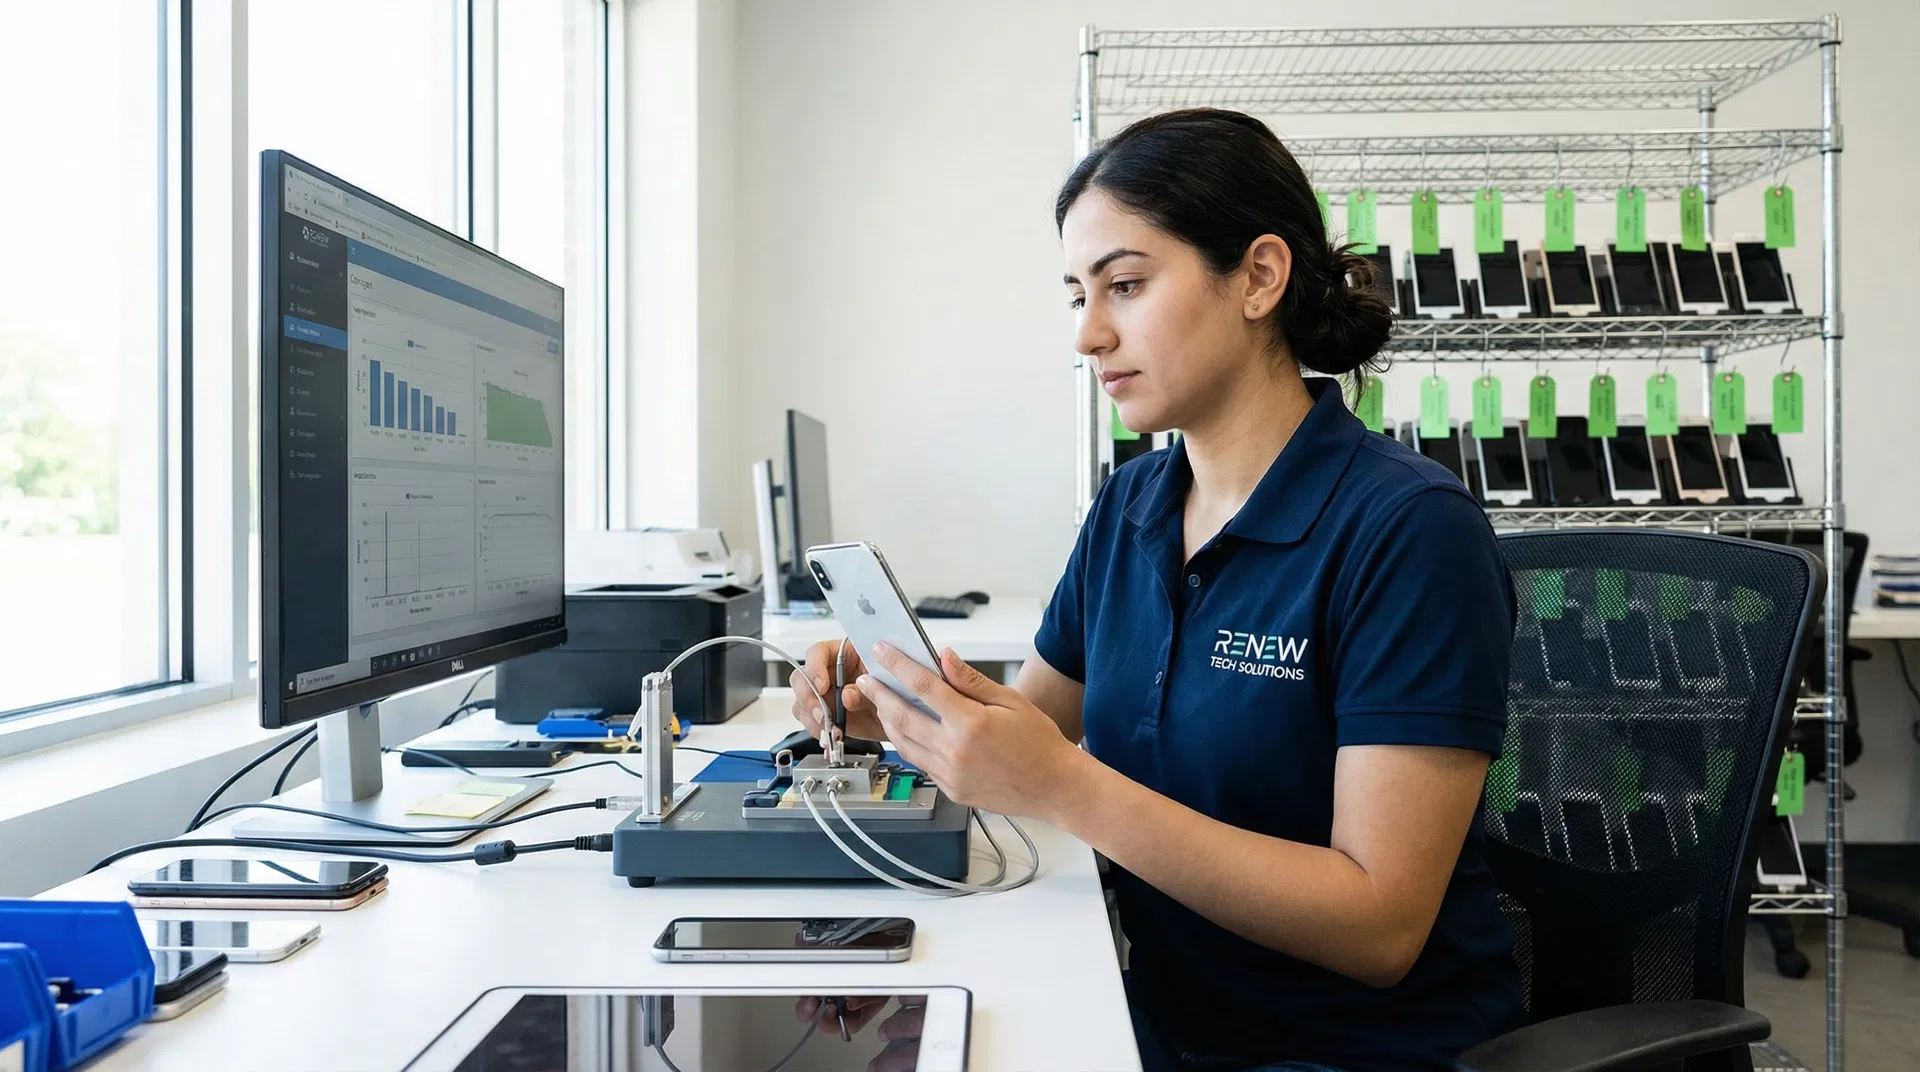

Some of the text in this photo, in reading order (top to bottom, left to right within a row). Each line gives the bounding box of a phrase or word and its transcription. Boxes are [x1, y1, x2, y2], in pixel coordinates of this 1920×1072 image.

[1214, 629, 1309, 664] RENEW
[451, 659, 465, 672] DELL
[1210, 655, 1305, 680] TECH SOLUTIONS
